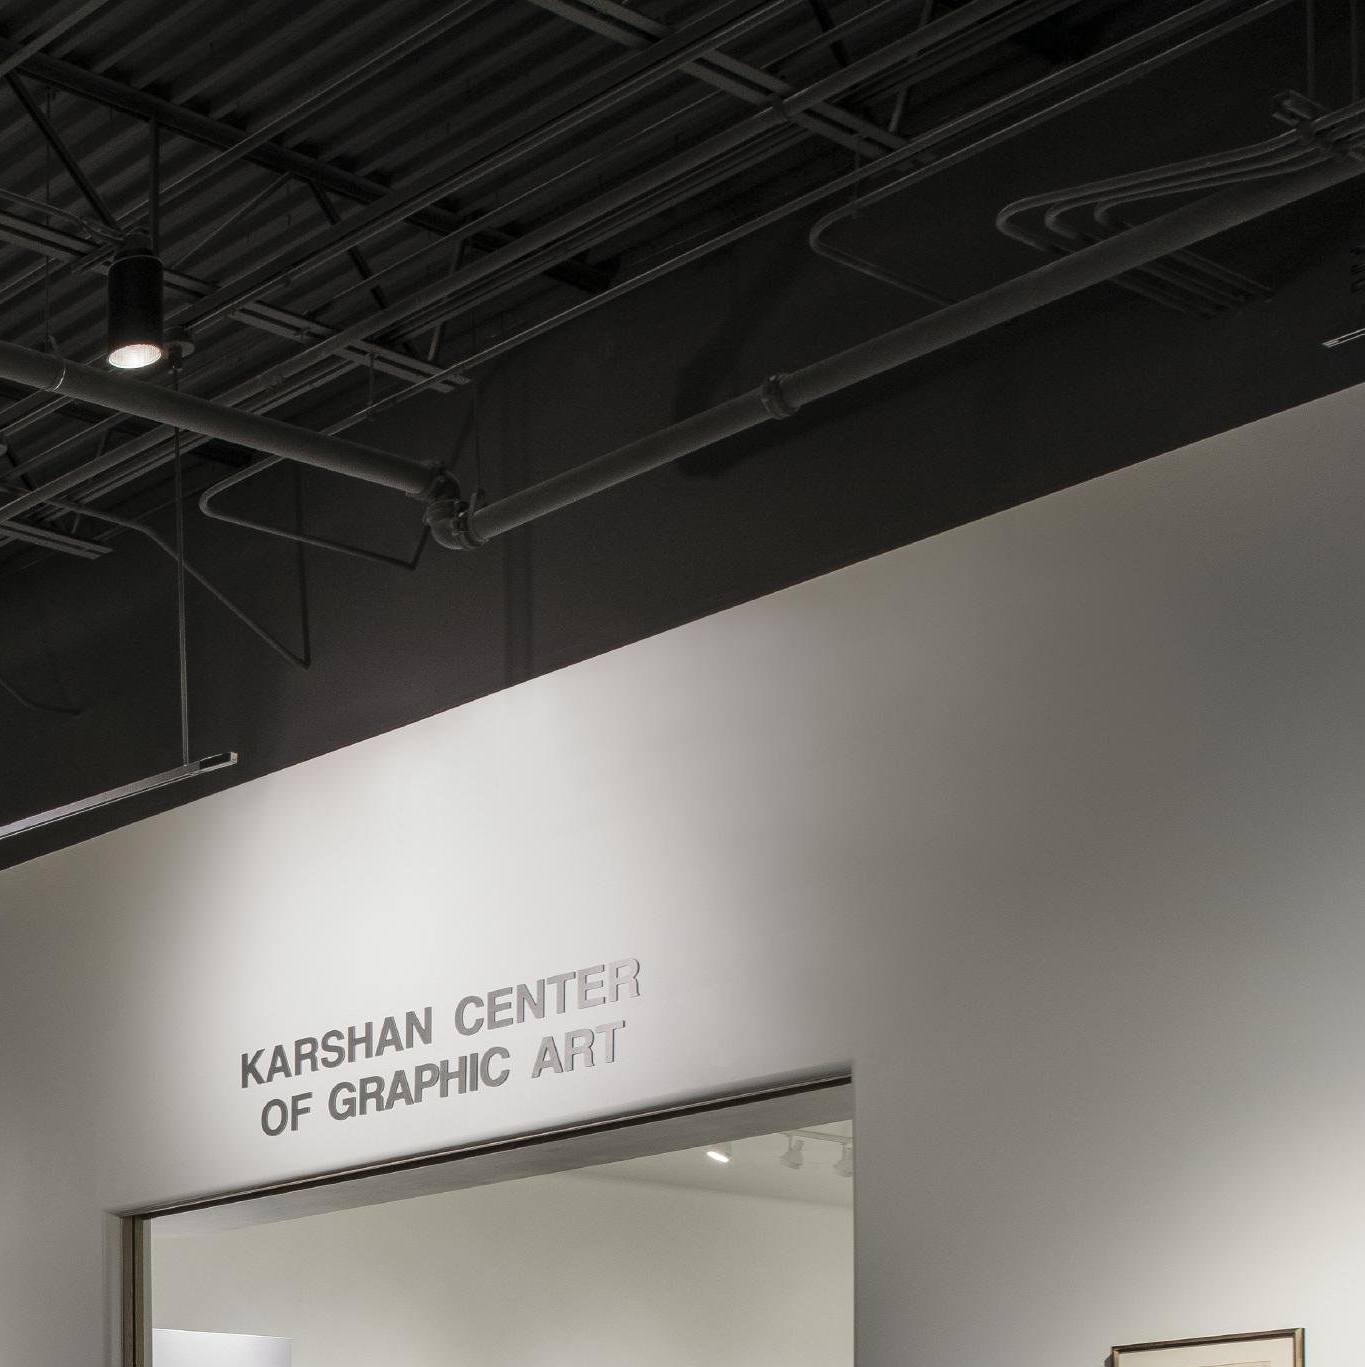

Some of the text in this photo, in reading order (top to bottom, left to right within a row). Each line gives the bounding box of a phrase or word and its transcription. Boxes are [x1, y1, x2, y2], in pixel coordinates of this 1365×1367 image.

[240, 957, 641, 1089] KARSHAN CENTER
[261, 1020, 626, 1136] OF GRAPHIC ART
